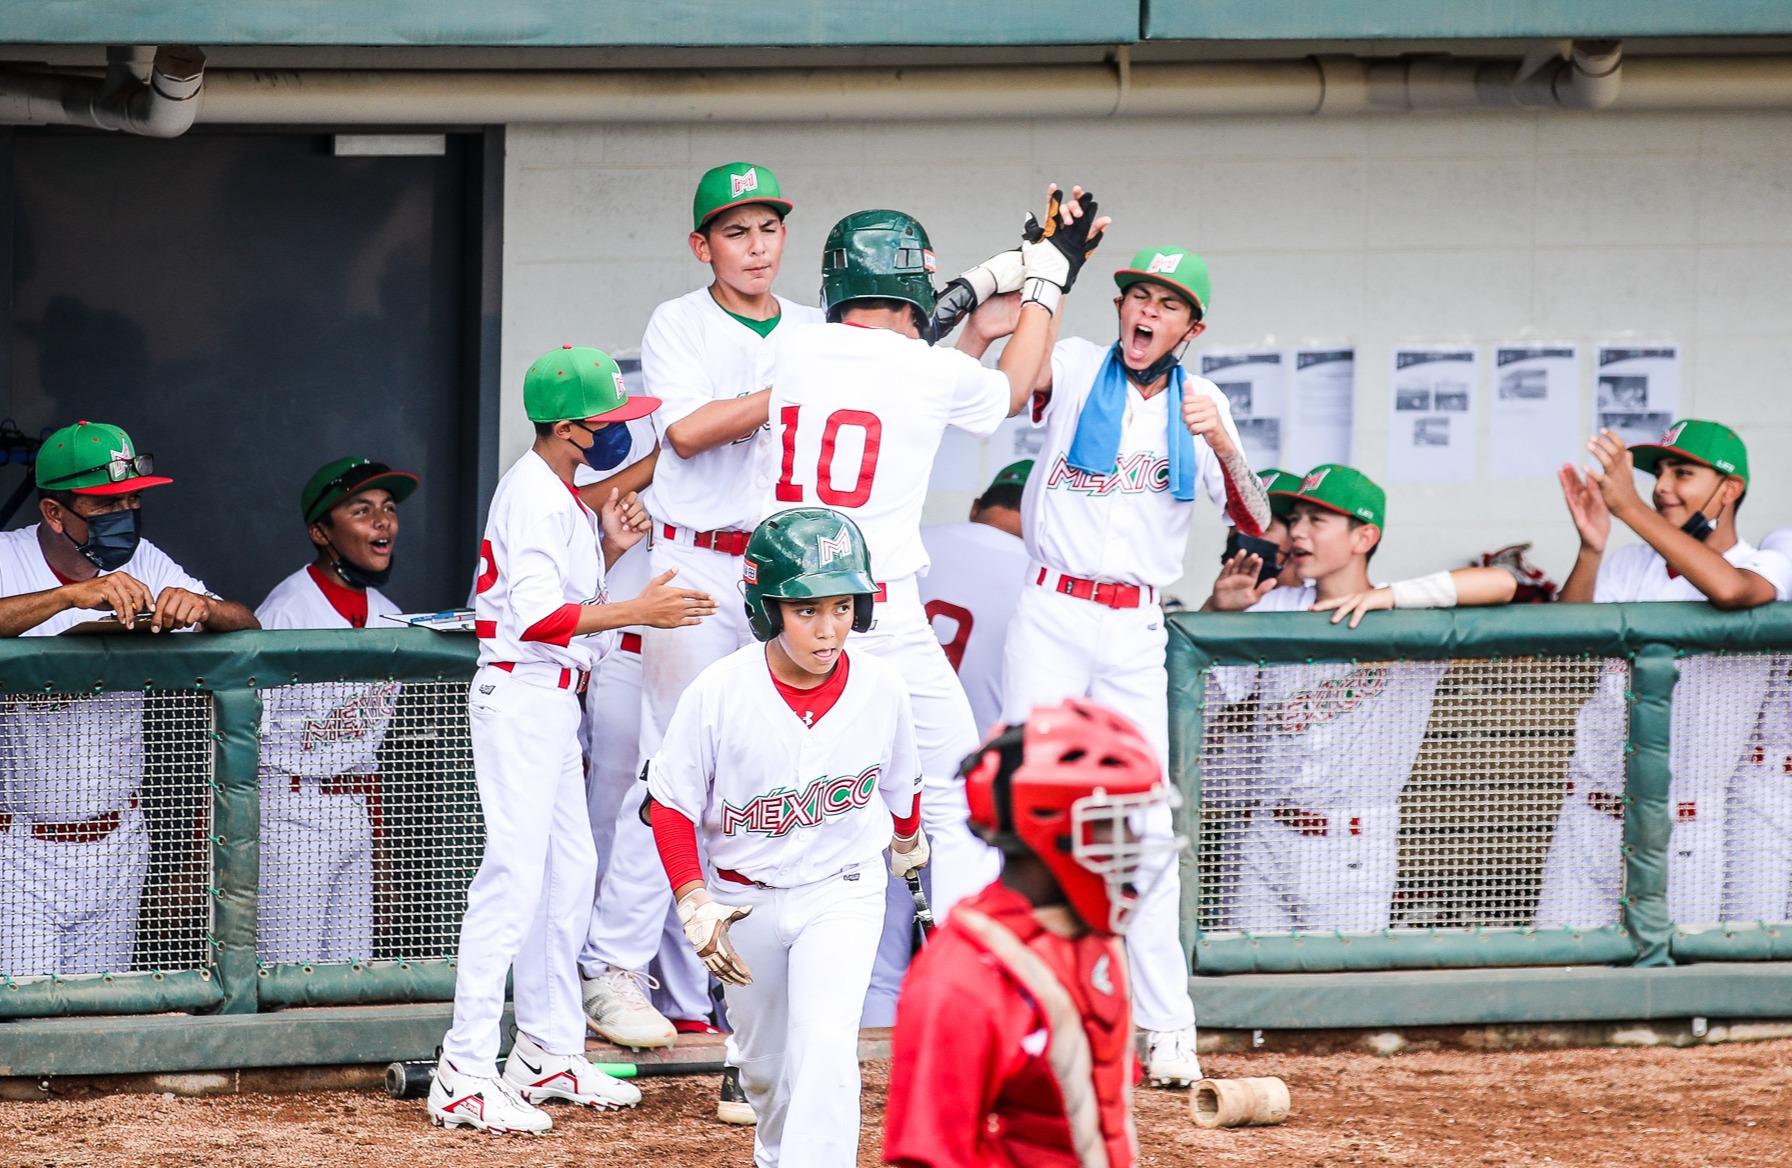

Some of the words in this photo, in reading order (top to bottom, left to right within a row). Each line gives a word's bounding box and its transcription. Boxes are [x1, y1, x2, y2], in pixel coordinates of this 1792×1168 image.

[730, 167, 758, 198] M
[1145, 252, 1184, 274] M
[775, 405, 883, 509] 10
[817, 523, 852, 568] M
